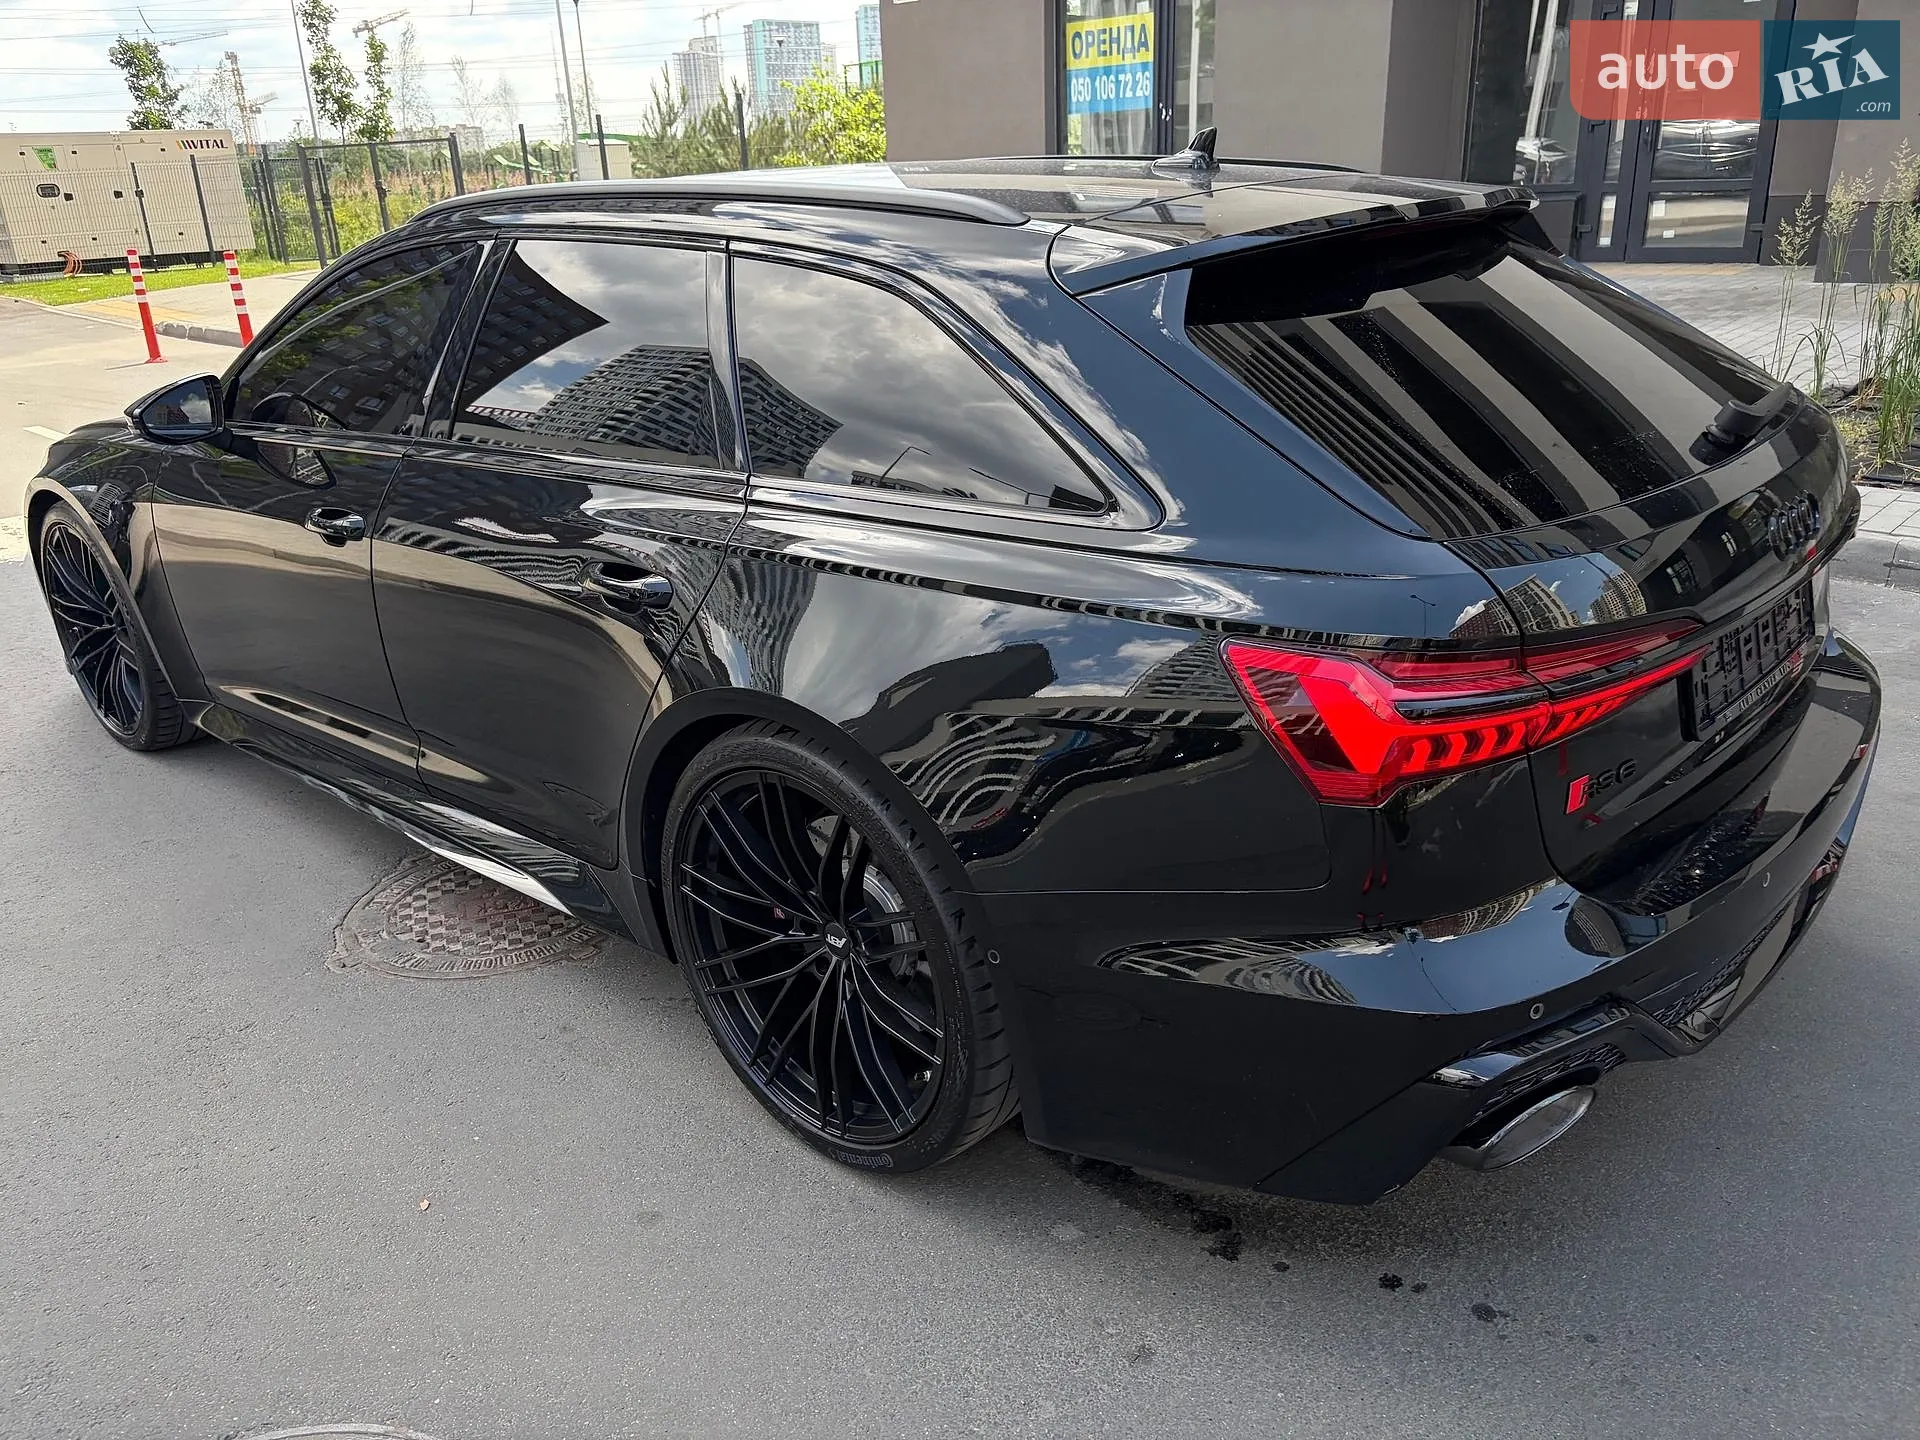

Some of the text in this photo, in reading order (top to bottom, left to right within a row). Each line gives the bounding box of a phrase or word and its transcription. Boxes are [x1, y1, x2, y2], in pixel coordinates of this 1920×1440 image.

[1071, 23, 1150, 61] ОРЕНДА
[1070, 71, 1151, 103] 050 106 72 26
[190, 139, 229, 150] VITAL
